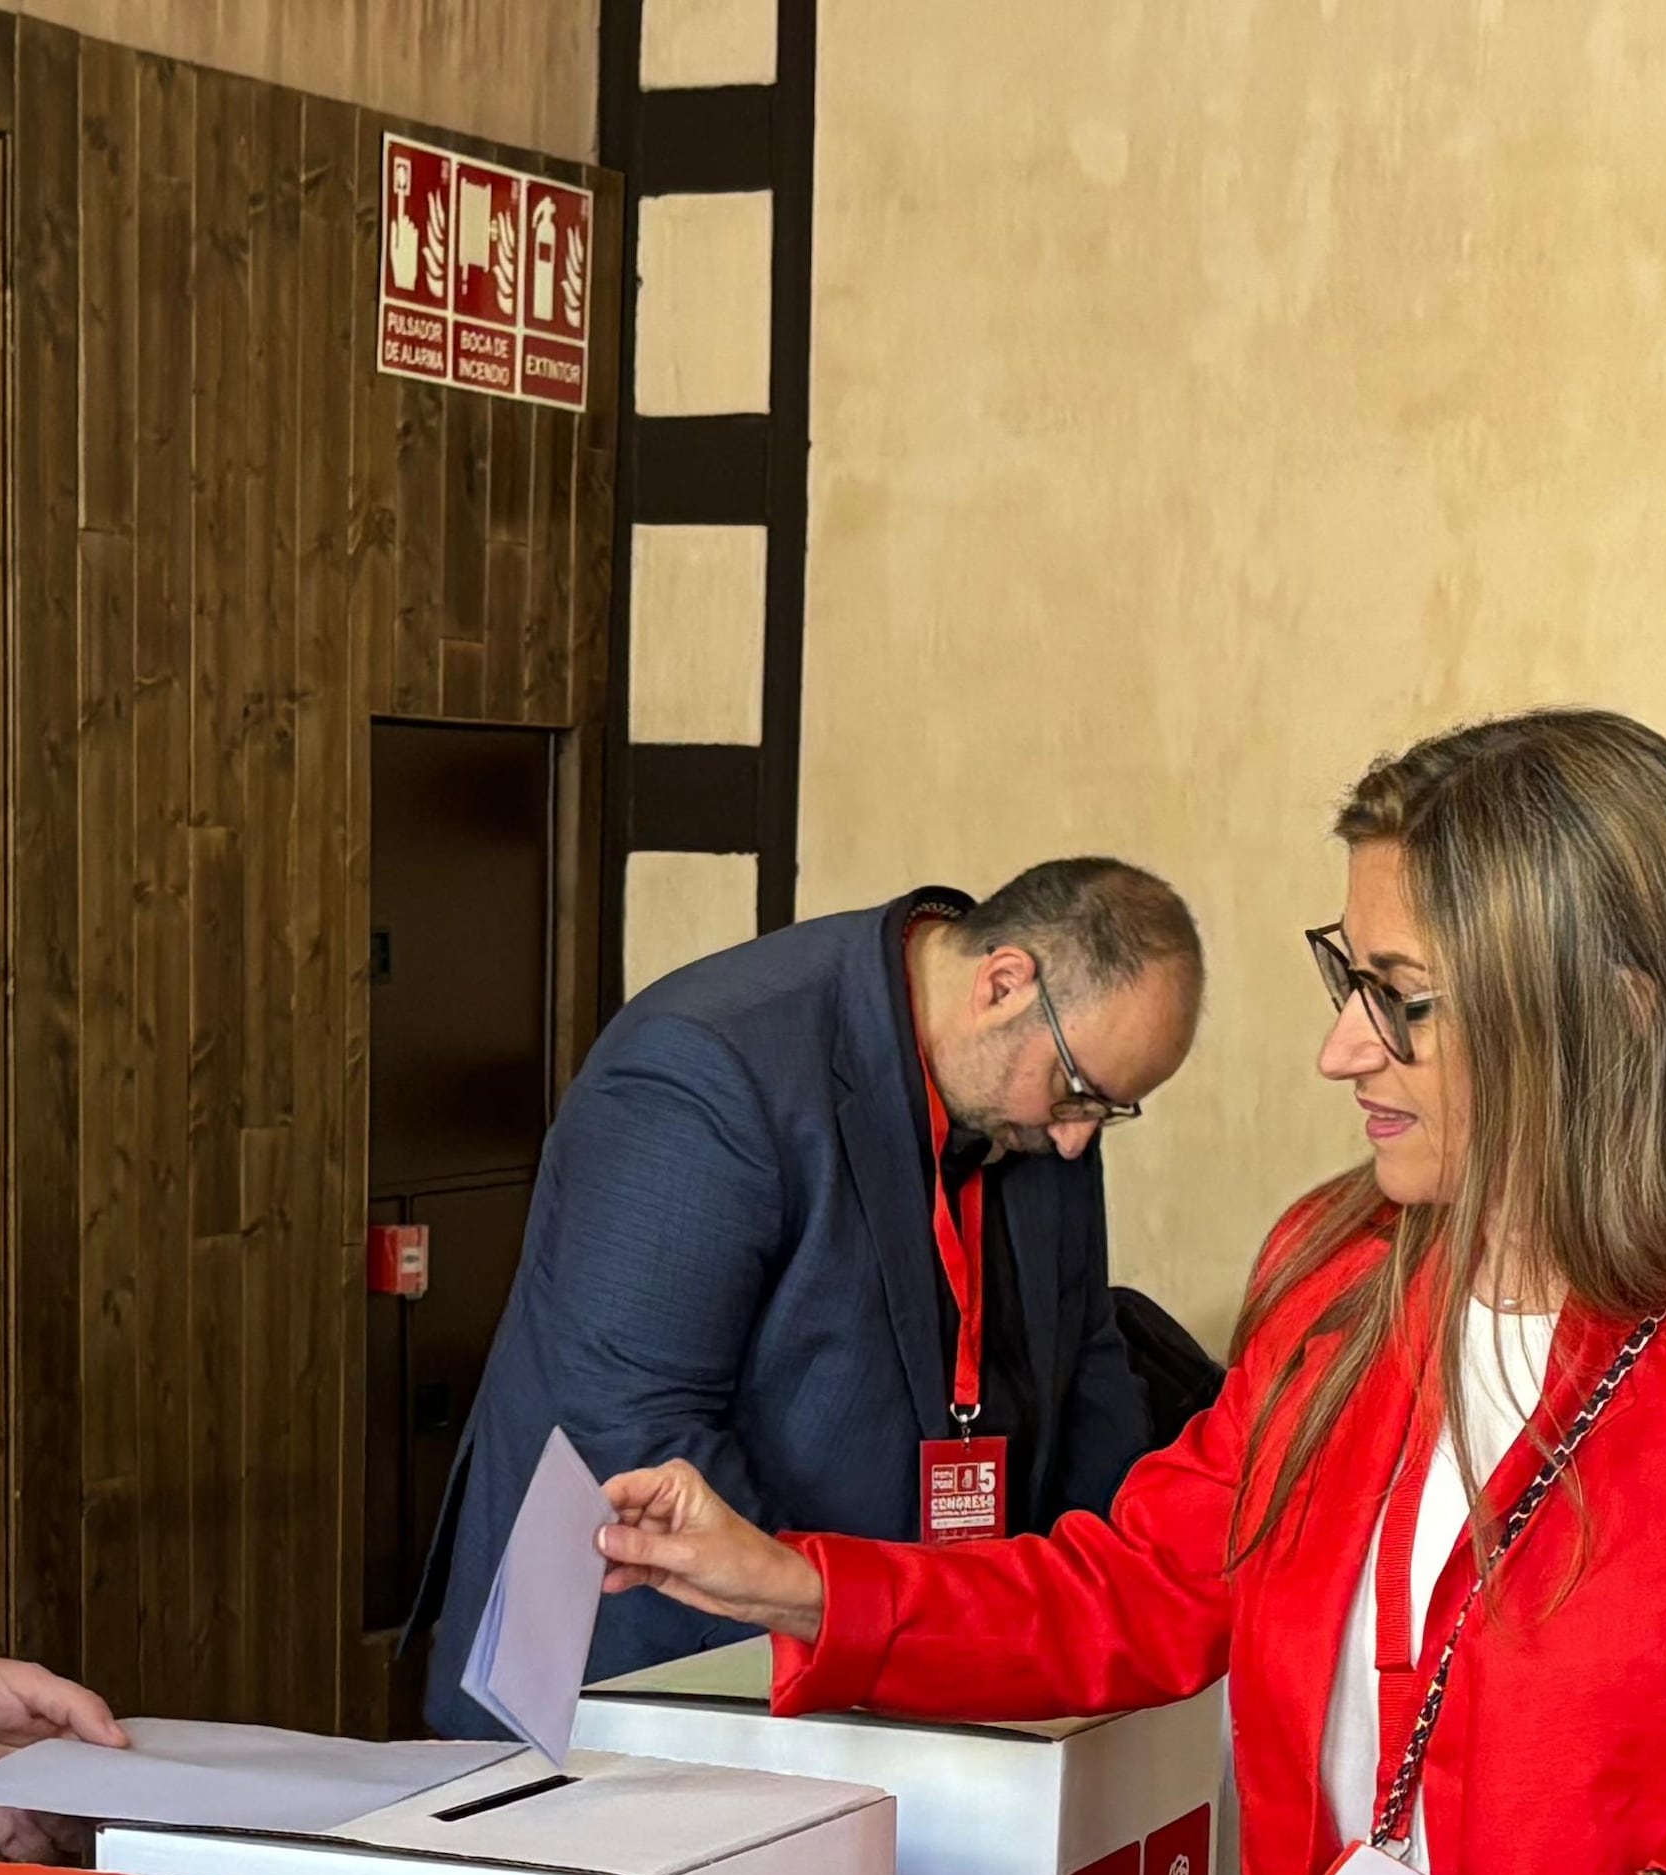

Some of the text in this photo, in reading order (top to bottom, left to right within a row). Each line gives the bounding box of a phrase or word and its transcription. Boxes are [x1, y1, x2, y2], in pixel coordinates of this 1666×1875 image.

[387, 312, 443, 343] PULSADOR
[385, 341, 444, 371] DE ALARMA
[460, 331, 509, 359] BOCA DE
[459, 357, 510, 386] INCENDIO
[525, 354, 581, 384] EXTINTOR
[978, 1462, 996, 1494] 5
